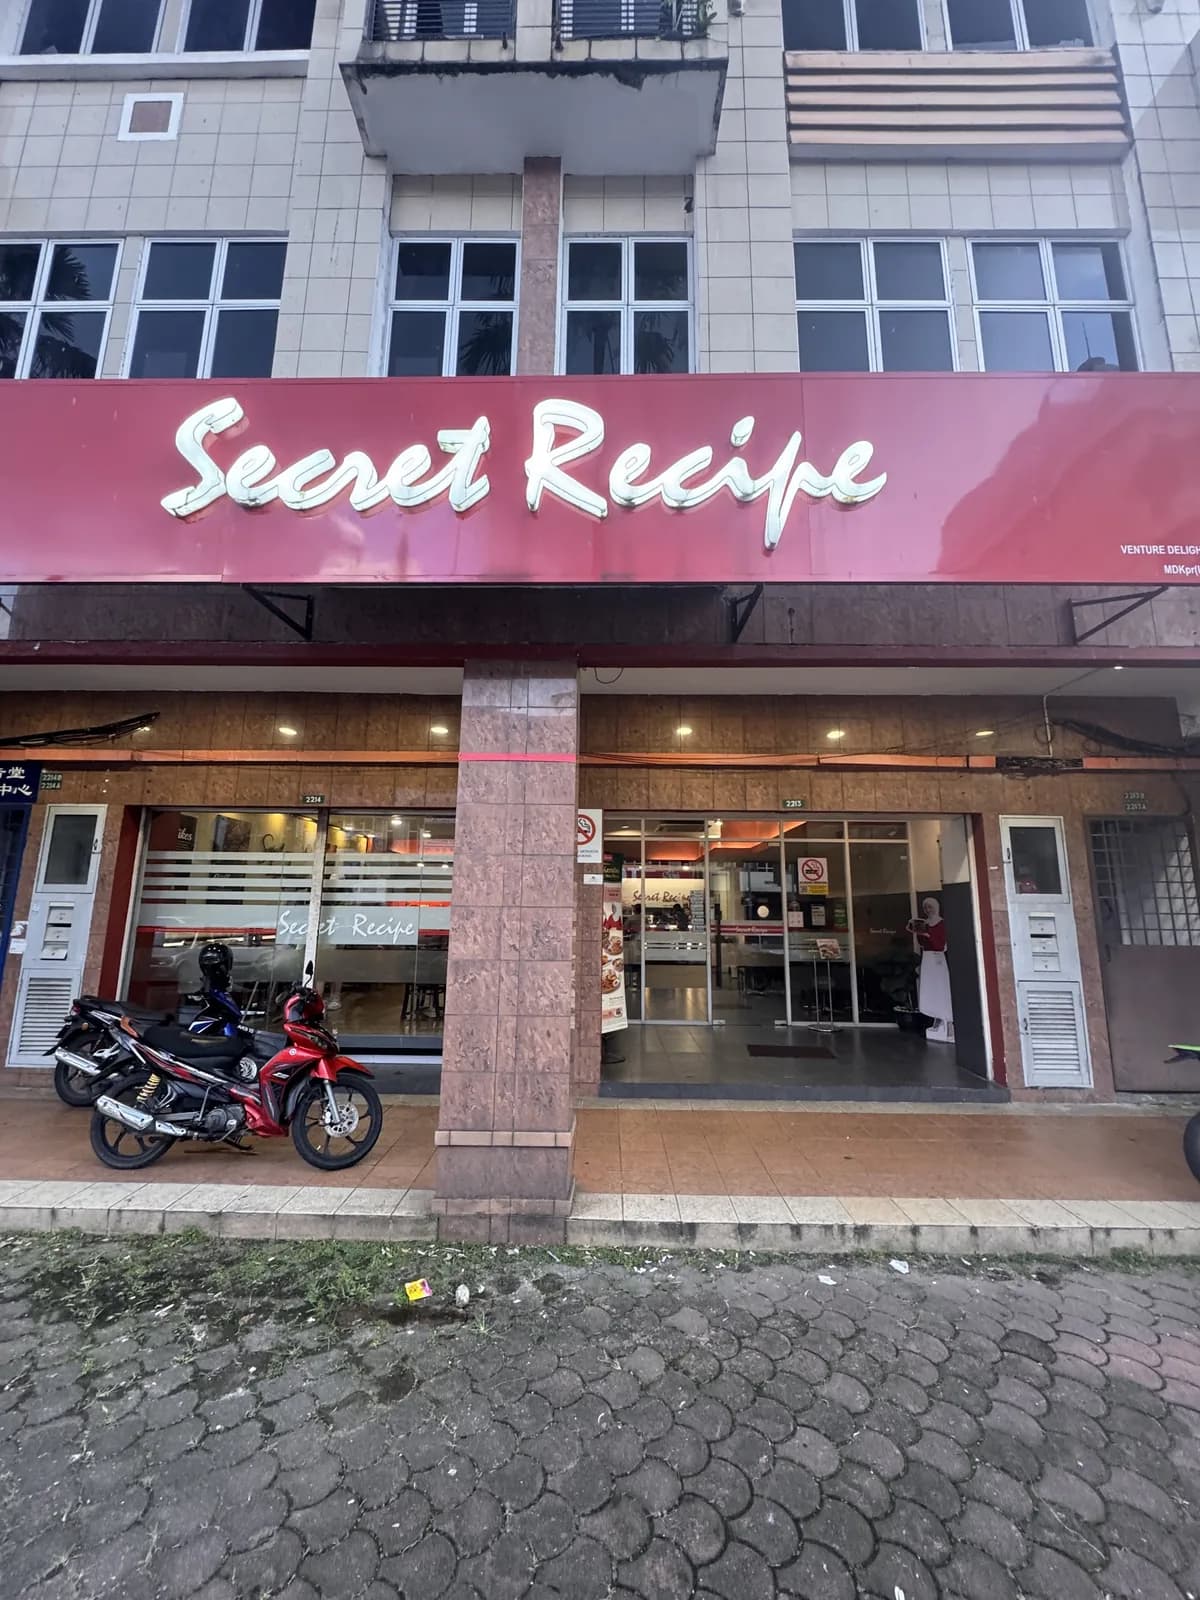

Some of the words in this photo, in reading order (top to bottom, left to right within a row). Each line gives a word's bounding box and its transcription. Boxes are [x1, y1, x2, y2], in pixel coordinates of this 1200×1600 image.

[160, 397, 491, 517] Secret
[524, 397, 889, 549] Recipe
[1120, 544, 1166, 554] VENTURE
[0, 783, 32, 796] 中心
[633, 890, 660, 902] Seret
[279, 910, 336, 936] Secet
[352, 913, 415, 944] Recipe
